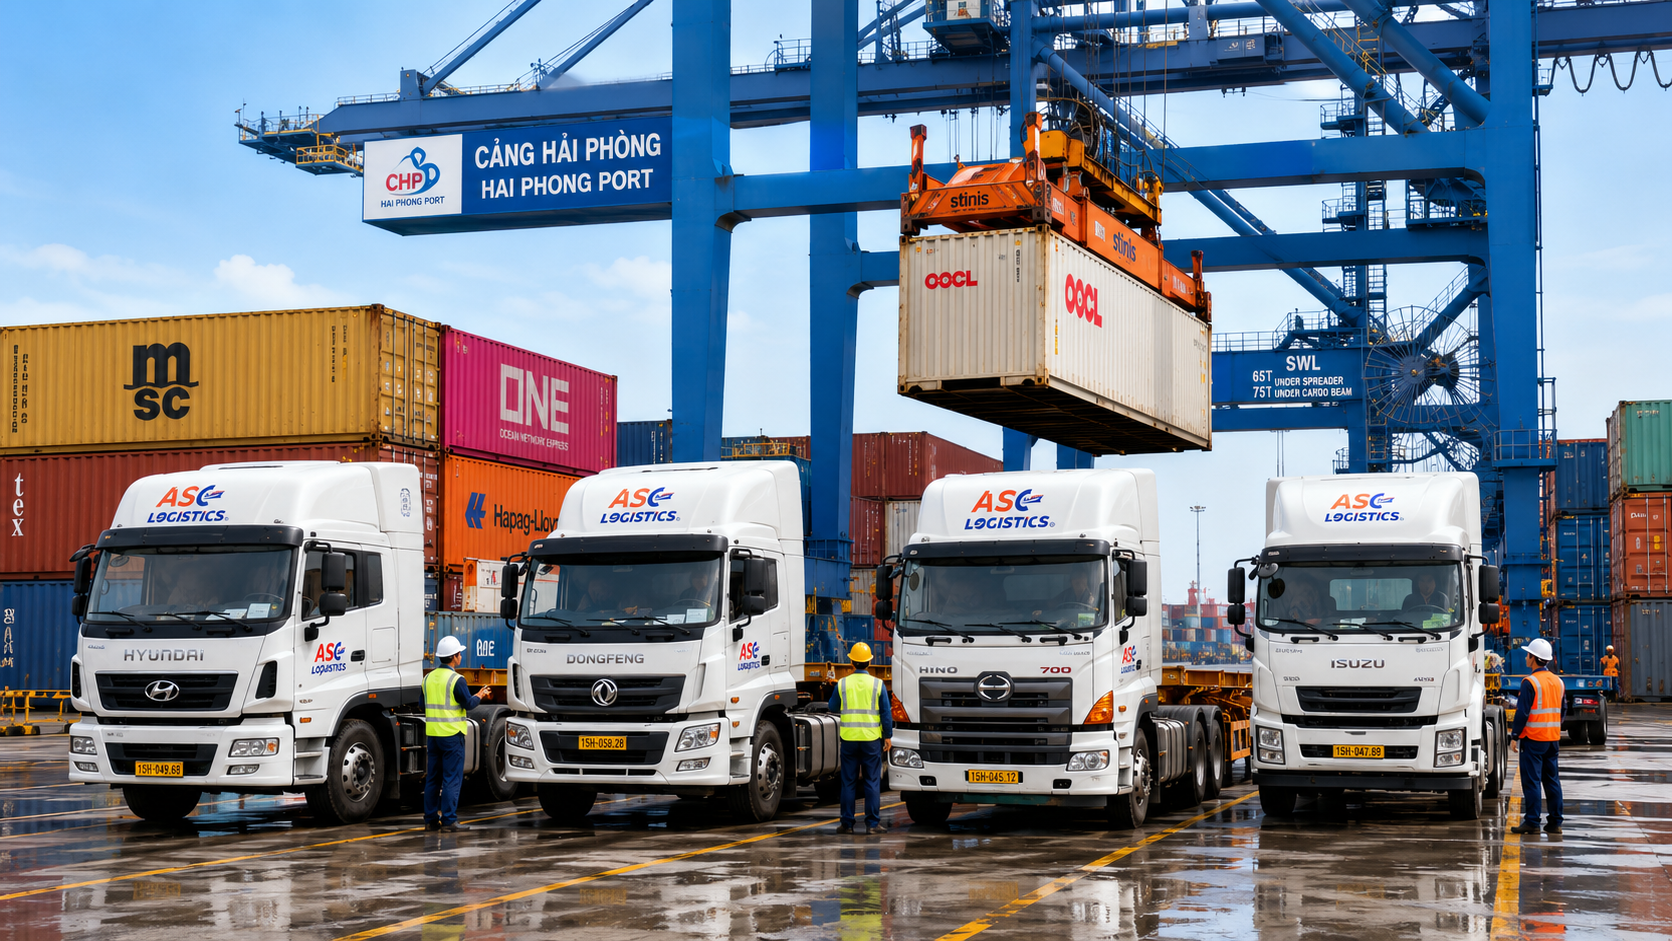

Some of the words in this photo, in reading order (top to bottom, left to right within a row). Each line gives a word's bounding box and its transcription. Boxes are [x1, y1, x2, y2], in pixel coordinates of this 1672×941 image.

[474, 137, 535, 169] CẢNG
[542, 132, 578, 164] HẢI
[585, 129, 661, 161] PHÒNG
[386, 172, 423, 191] CHP
[481, 178, 514, 199] HAI
[521, 173, 592, 196] PHONG
[598, 168, 653, 191] PORT
[380, 200, 394, 208] HAI
[395, 197, 422, 207] PHONG
[424, 196, 445, 205] PORT
[950, 191, 989, 208] stinis
[1112, 231, 1136, 263] stinis
[925, 270, 978, 290] OOCL
[1065, 273, 1102, 328] OOCL
[1286, 354, 1321, 371] SWL
[1252, 370, 1273, 382] 65T
[1302, 376, 1344, 386] SPREADER
[500, 363, 569, 435] ONE
[1253, 386, 1272, 398] 75T
[1330, 387, 1352, 396] BEAM
[11, 472, 24, 537] tex
[155, 485, 218, 507] ASC
[608, 487, 666, 508] ASC
[970, 489, 1033, 513] ASC
[1330, 493, 1385, 510] ASC
[147, 510, 226, 523] LOGISTICS
[494, 503, 558, 536] Hapag-Lloy
[600, 511, 677, 523] LOGISTICS
[964, 516, 1050, 530] LOGISTICS
[1324, 512, 1400, 522] LOGISTICS
[124, 649, 204, 662] HYUNDAI
[314, 642, 343, 662] ASC
[566, 653, 645, 664] DONGFENG
[739, 642, 759, 661] ASC
[919, 666, 958, 674] HINO
[1040, 666, 1072, 674] 700
[1331, 659, 1385, 669] ISUZU
